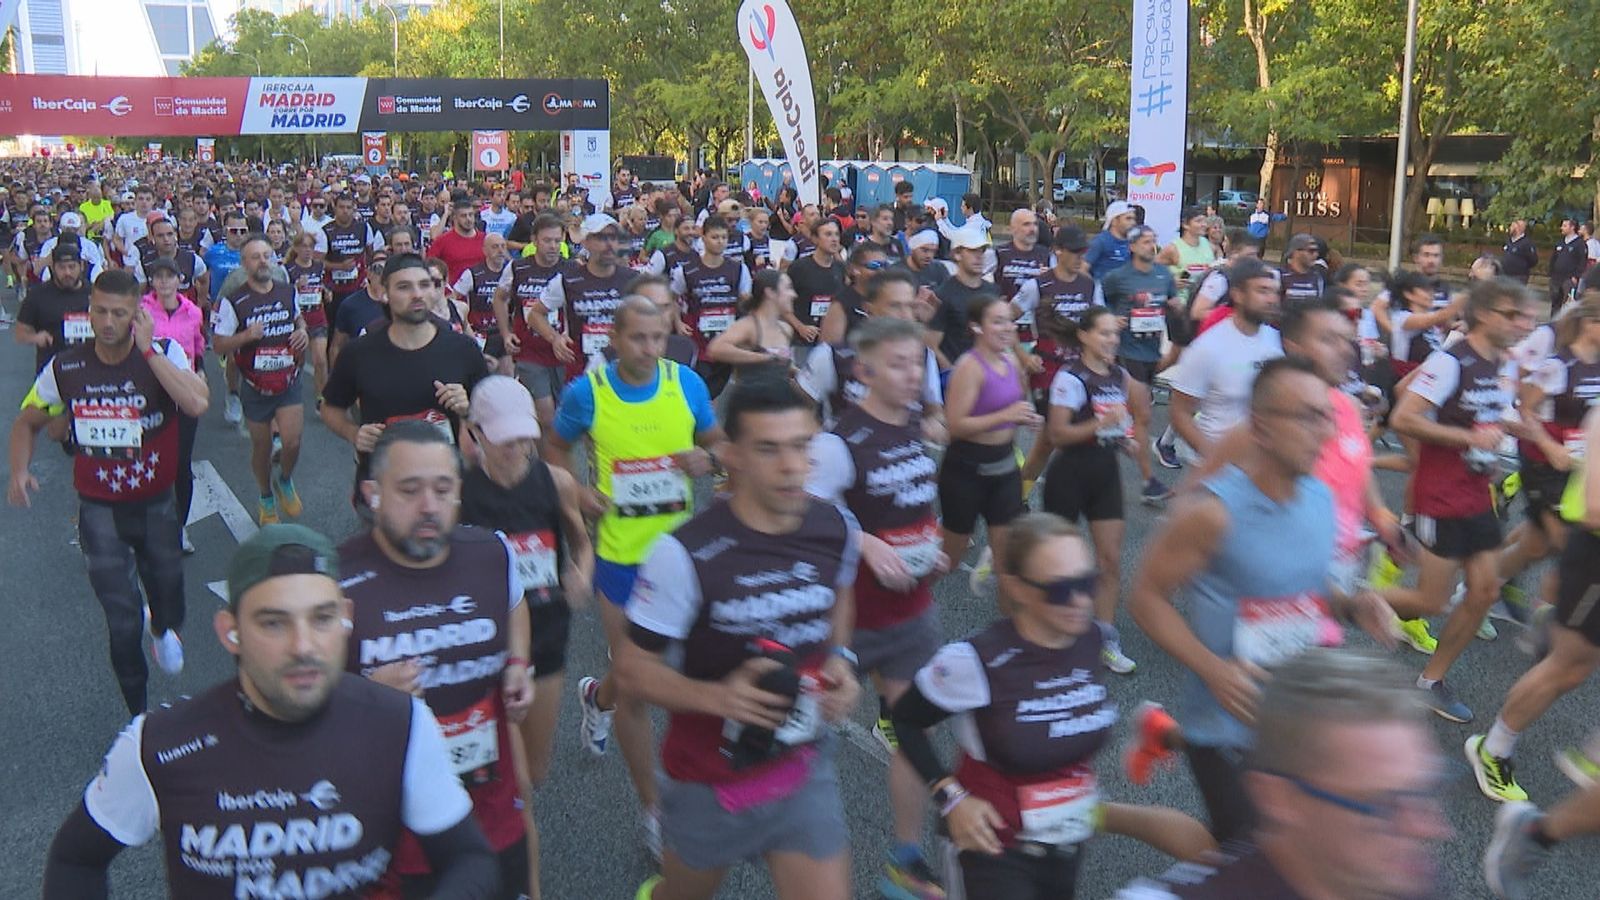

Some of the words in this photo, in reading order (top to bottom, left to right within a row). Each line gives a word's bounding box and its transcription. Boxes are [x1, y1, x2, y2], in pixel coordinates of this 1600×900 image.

[262, 83, 314, 92] IBERCAJA
[174, 97, 227, 106] Comunidad
[259, 93, 336, 107] MADRID
[396, 96, 441, 104] Comunidad
[175, 106, 189, 115] de
[191, 106, 227, 115] Madrid
[396, 104, 408, 113] de
[410, 104, 441, 113] Madrid
[271, 113, 347, 128] MADRID
[371, 151, 378, 161] 2
[487, 151, 493, 164] 1
[1296, 191, 1328, 200] ROYAL
[89, 426, 127, 441] 2147
[360, 618, 497, 665] MADRID
[180, 812, 364, 859] MADRID
